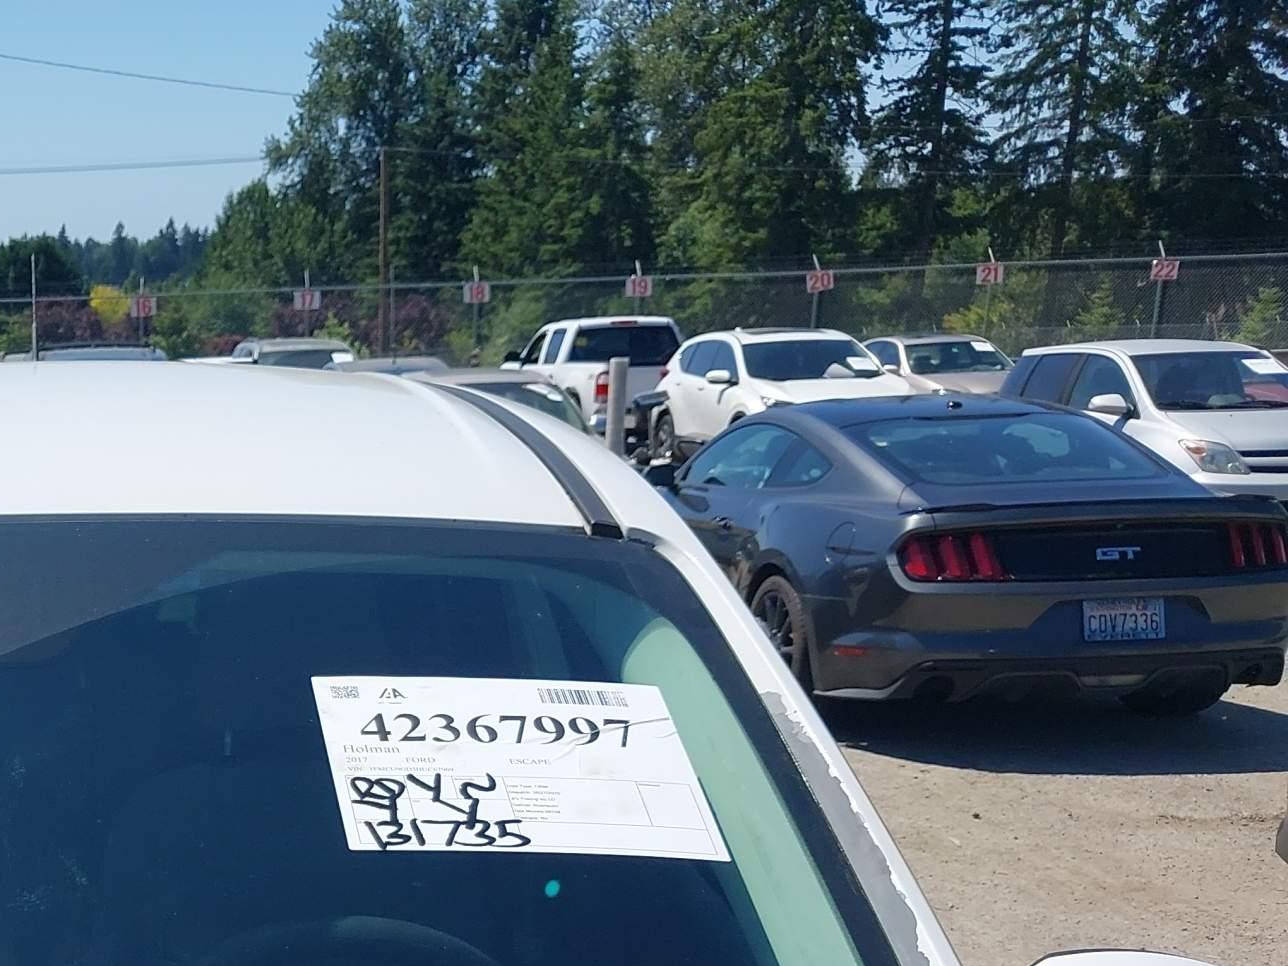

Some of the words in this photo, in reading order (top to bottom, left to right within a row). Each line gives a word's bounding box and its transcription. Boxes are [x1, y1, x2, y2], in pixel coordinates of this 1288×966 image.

[982, 266, 999, 282] 21
[1153, 262, 1176, 278] 22
[632, 277, 649, 295] 19
[809, 272, 831, 289] 20
[468, 284, 485, 301] 18
[136, 297, 152, 315] 16
[1096, 547, 1142, 560] GT
[360, 712, 631, 748] 42367997
[343, 744, 400, 754] Holman
[509, 758, 552, 766] ESCAPE
[363, 818, 532, 850] 131735
